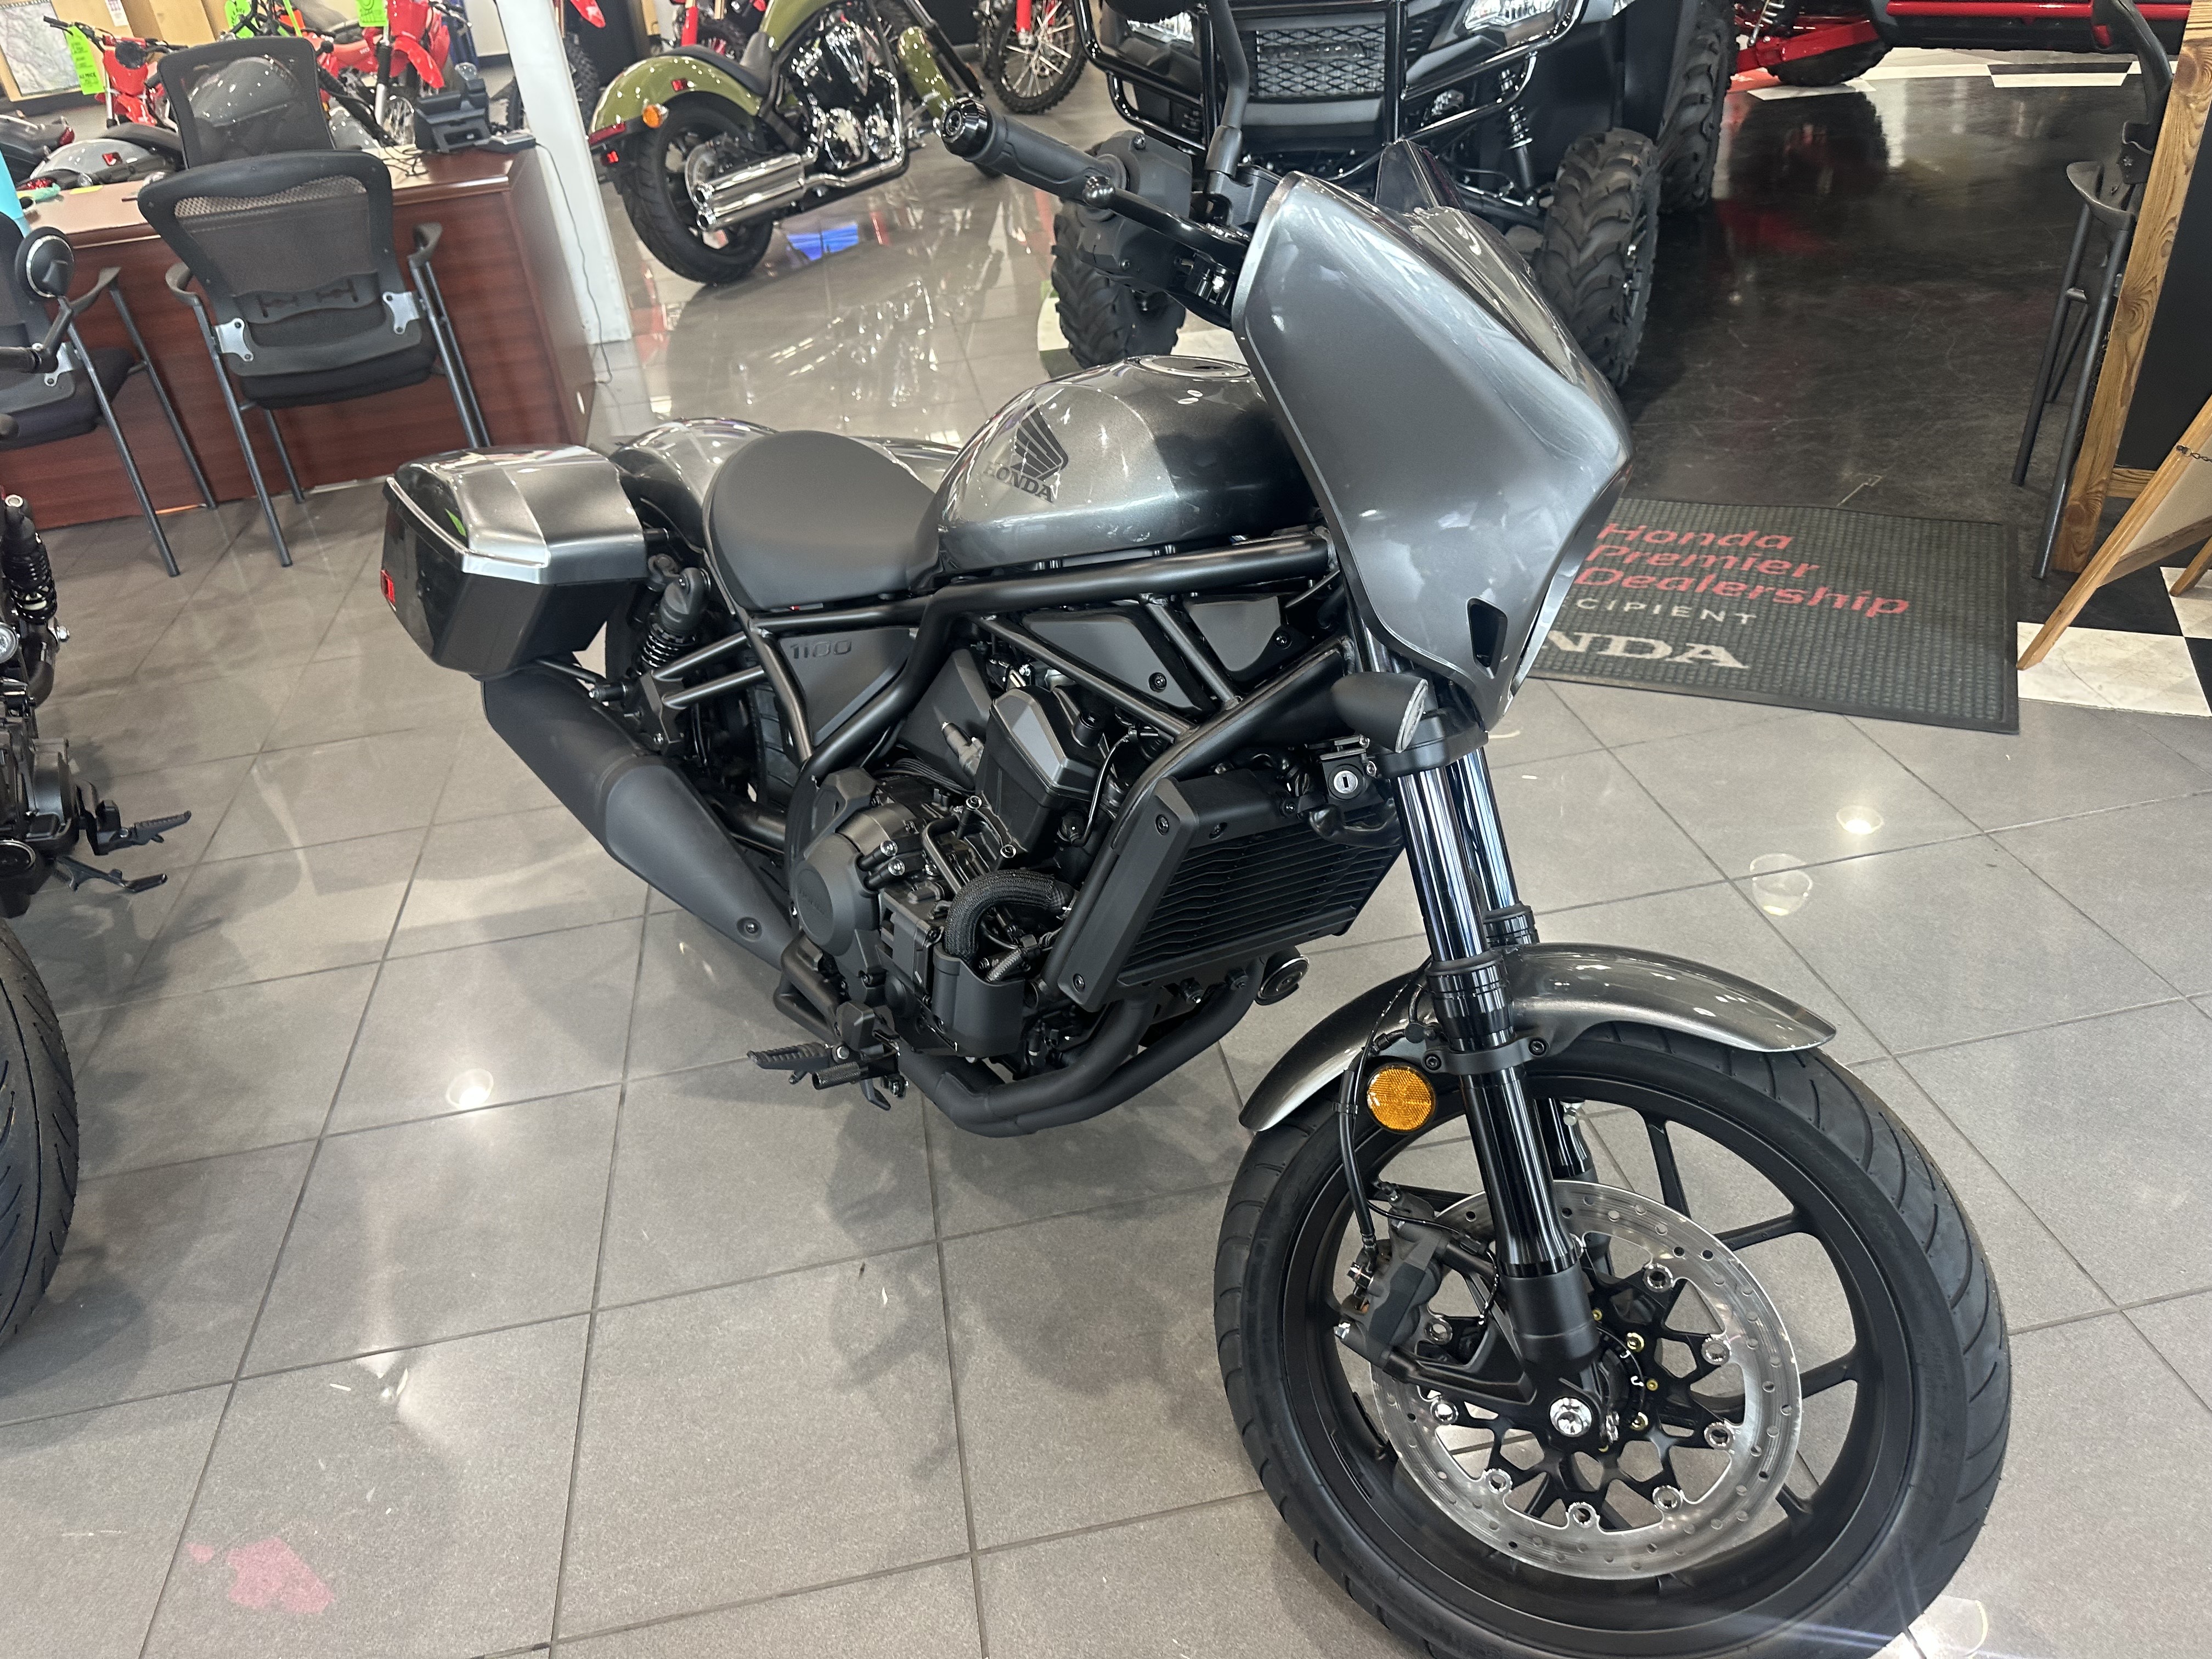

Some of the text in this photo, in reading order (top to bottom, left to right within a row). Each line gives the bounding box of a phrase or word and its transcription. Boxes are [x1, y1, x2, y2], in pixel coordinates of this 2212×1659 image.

[983, 461, 1053, 503] HONDA
[1596, 523, 1794, 549] Honda
[1584, 544, 1819, 578] Premier
[1573, 566, 1909, 617] Dealership
[1563, 596, 1757, 624] CIPIENT
[790, 640, 852, 658] 1100
[1543, 630, 1751, 669] NDA
